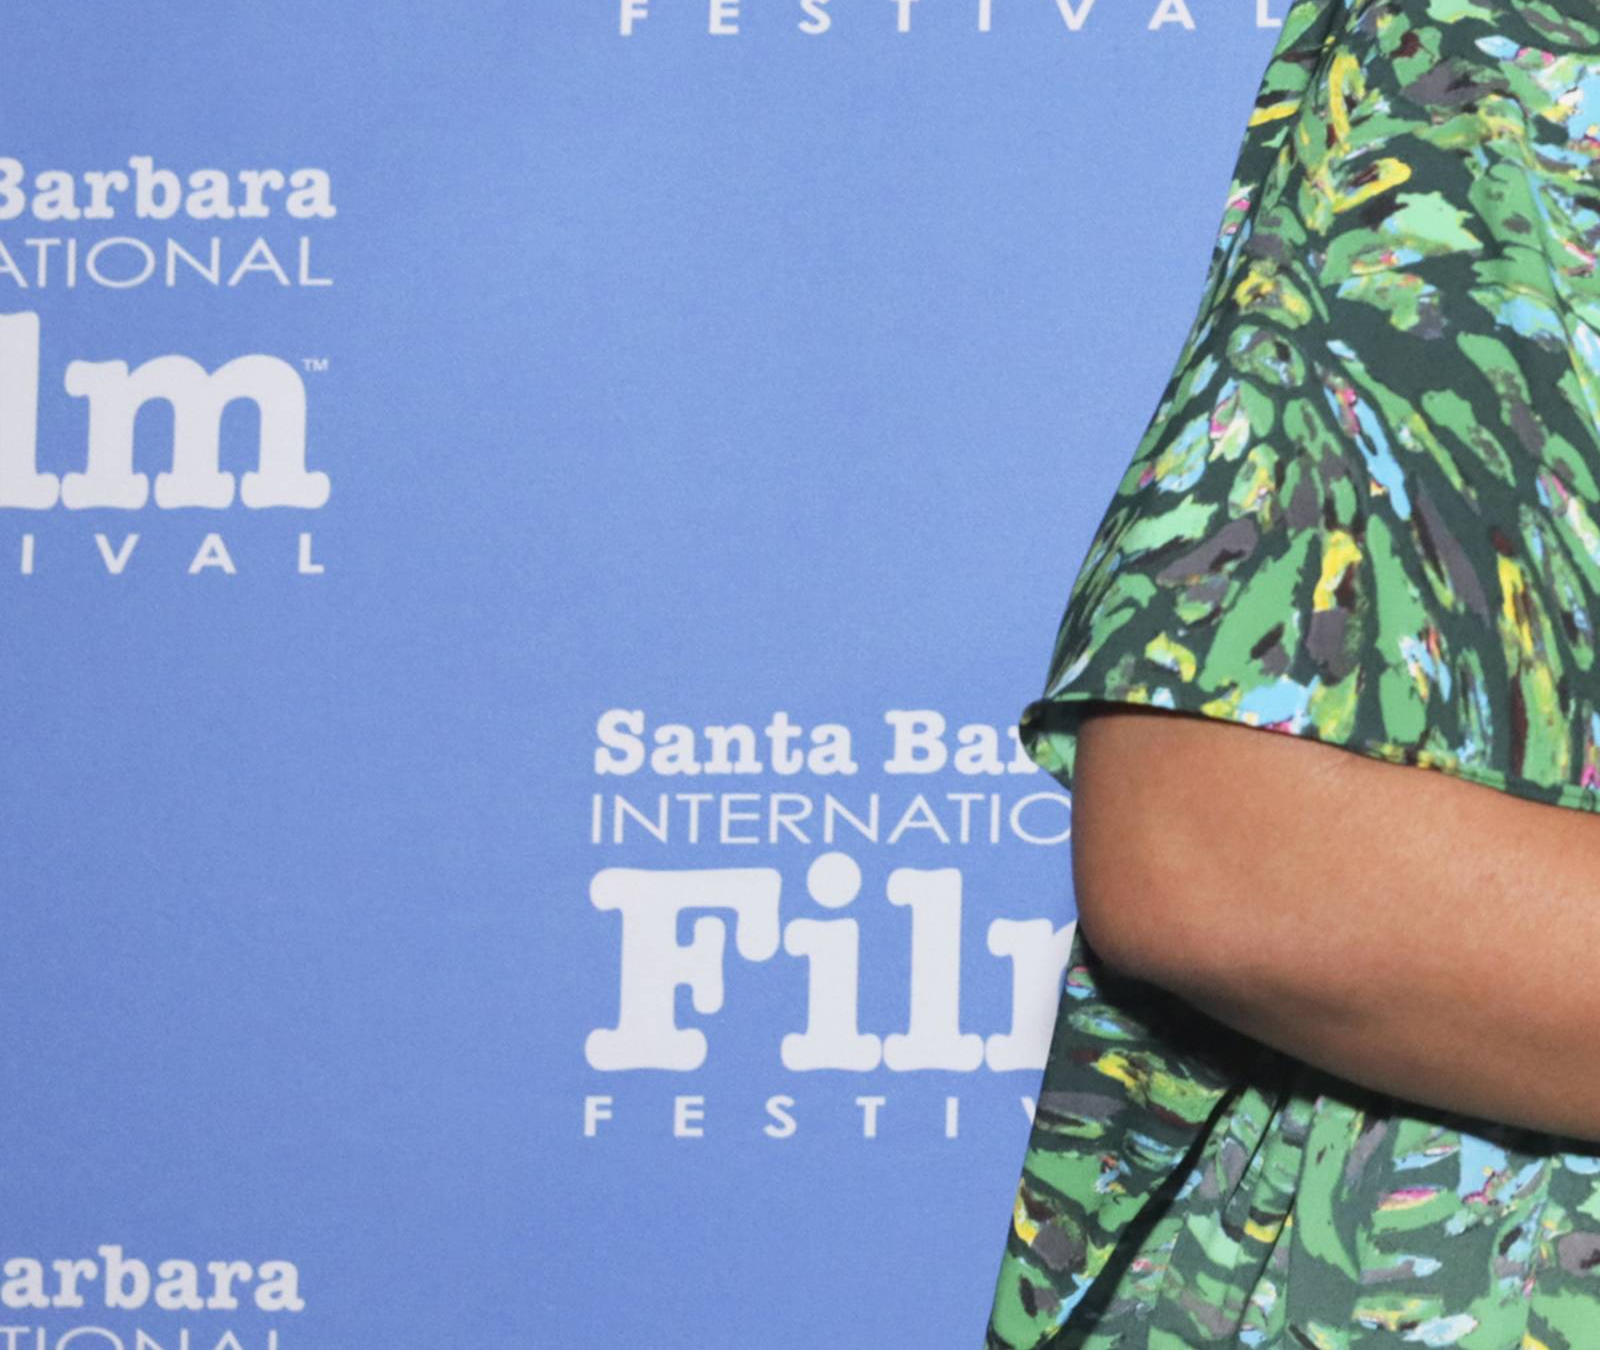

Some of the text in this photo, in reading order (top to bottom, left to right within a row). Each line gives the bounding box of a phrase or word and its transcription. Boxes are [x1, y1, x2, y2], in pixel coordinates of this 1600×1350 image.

[0, 311, 332, 511] lm
[21, 532, 325, 575] IVAL
[594, 708, 859, 776] Santa
[591, 792, 1072, 845] INTERNATIO
[583, 1094, 1037, 1139] FESTI
[0, 1244, 306, 1312] arbara
